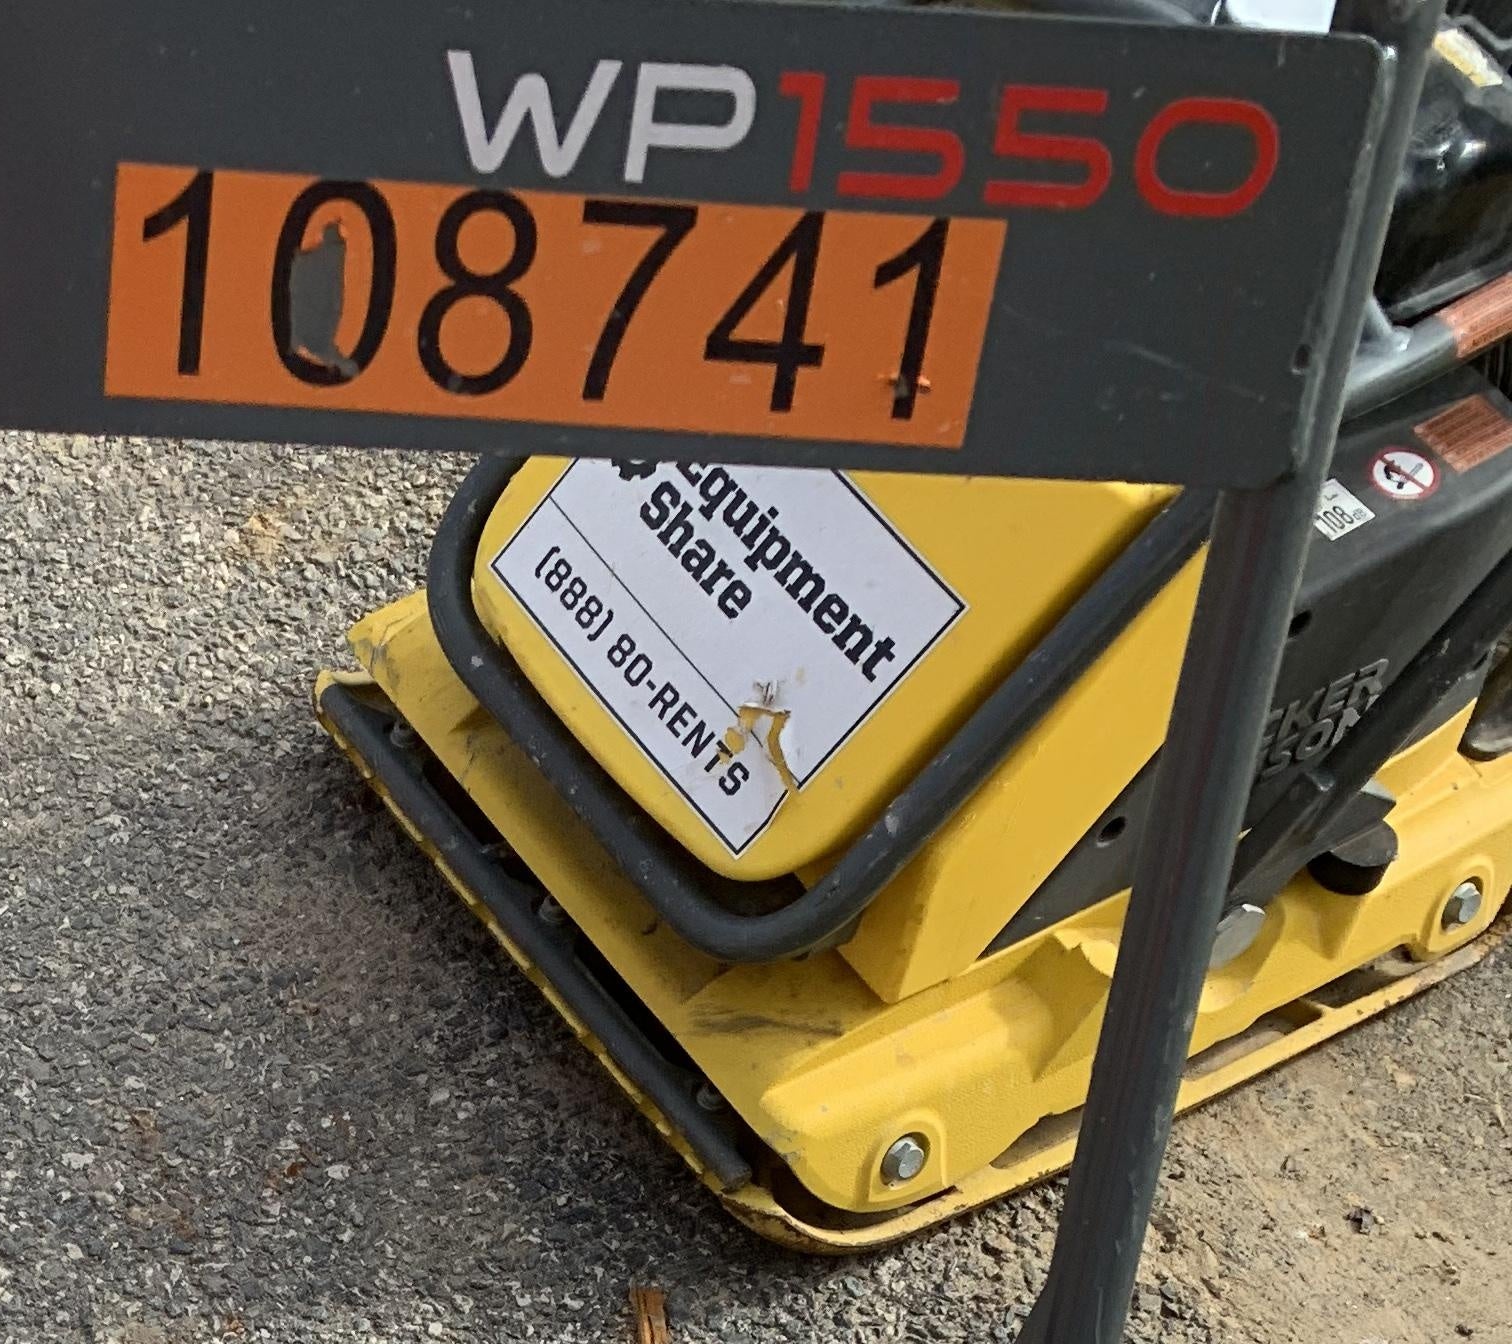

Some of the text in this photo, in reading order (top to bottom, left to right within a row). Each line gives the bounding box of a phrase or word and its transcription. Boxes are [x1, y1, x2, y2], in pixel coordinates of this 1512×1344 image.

[447, 49, 1280, 218] WP1550
[140, 169, 952, 420] 108741
[639, 480, 753, 619] Share
[534, 545, 751, 797] (888) 80-RENTS
